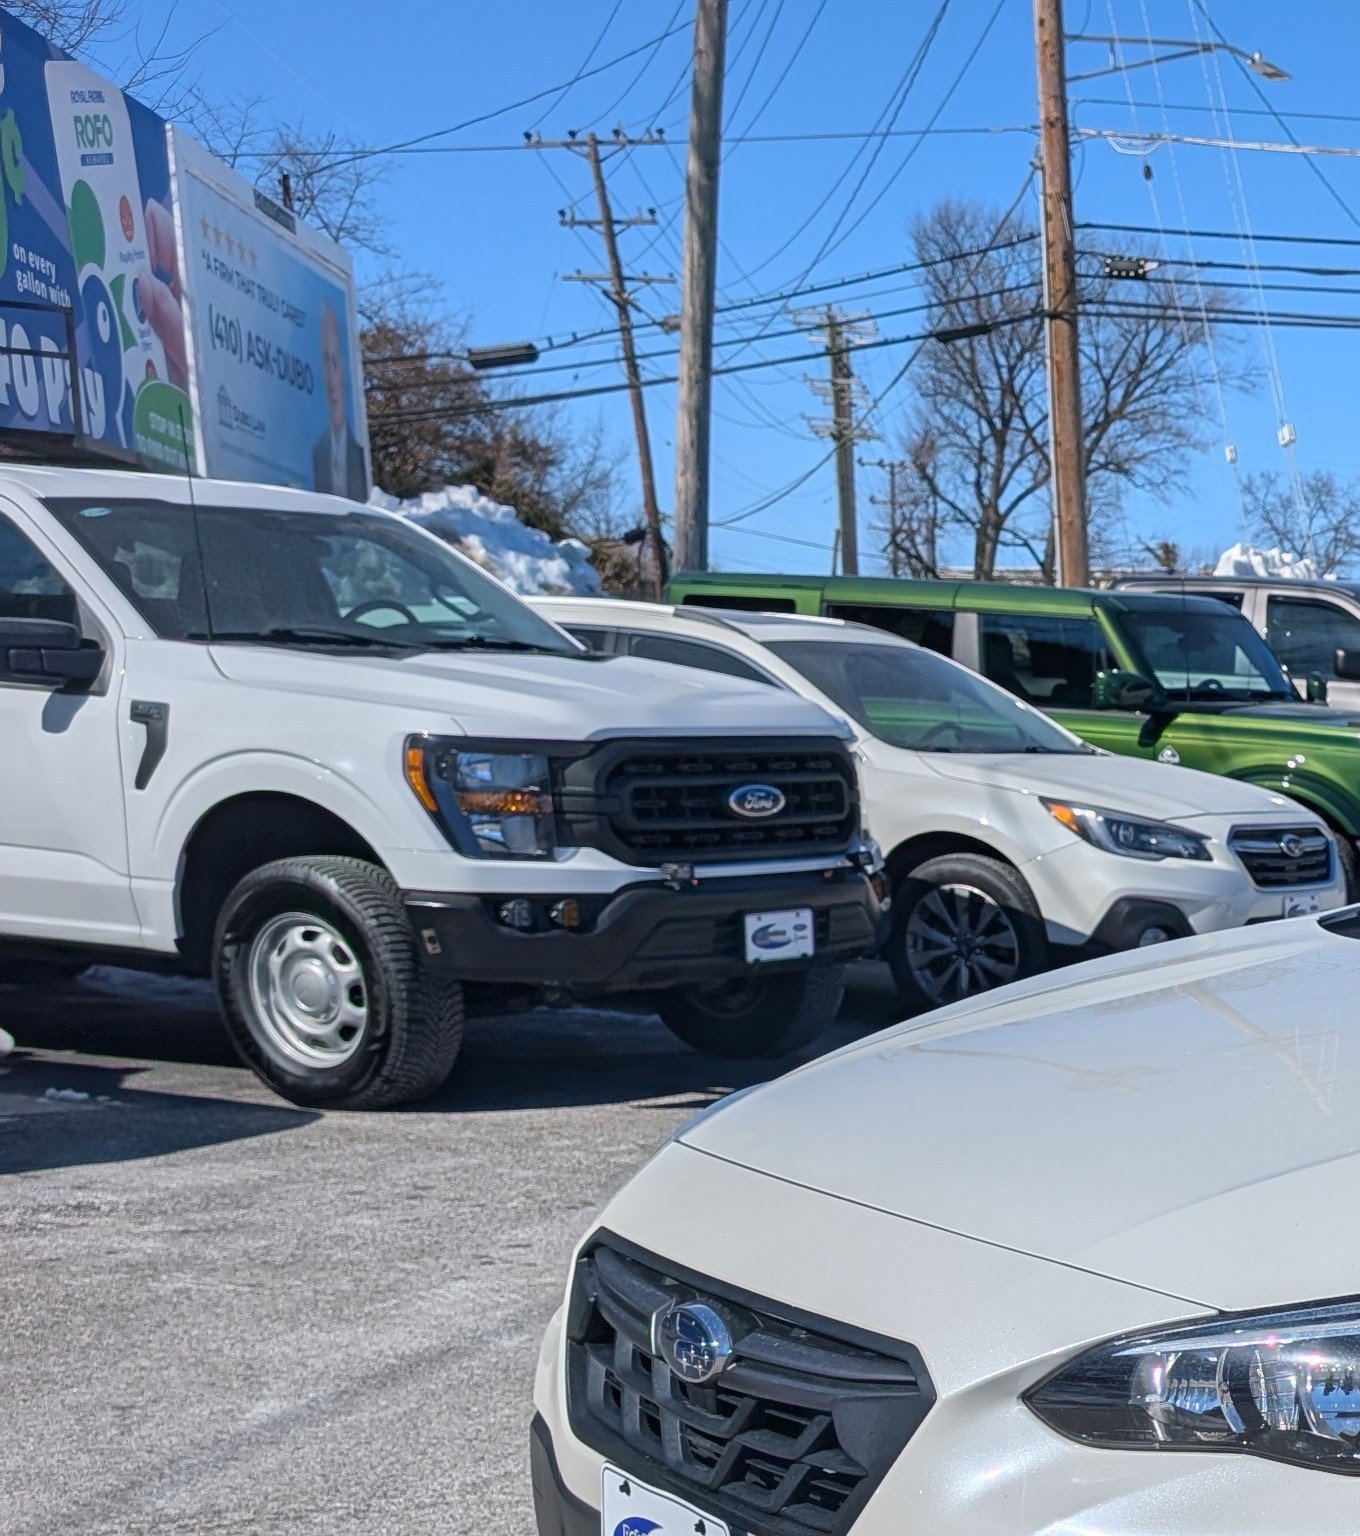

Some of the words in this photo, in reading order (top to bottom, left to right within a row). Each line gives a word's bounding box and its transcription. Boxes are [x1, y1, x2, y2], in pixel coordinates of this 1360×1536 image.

[73, 113, 114, 148] ROFO
[13, 243, 27, 263] on
[28, 249, 57, 284] every
[15, 269, 49, 300] gallon
[48, 284, 72, 308] with
[208, 302, 244, 364] (410)
